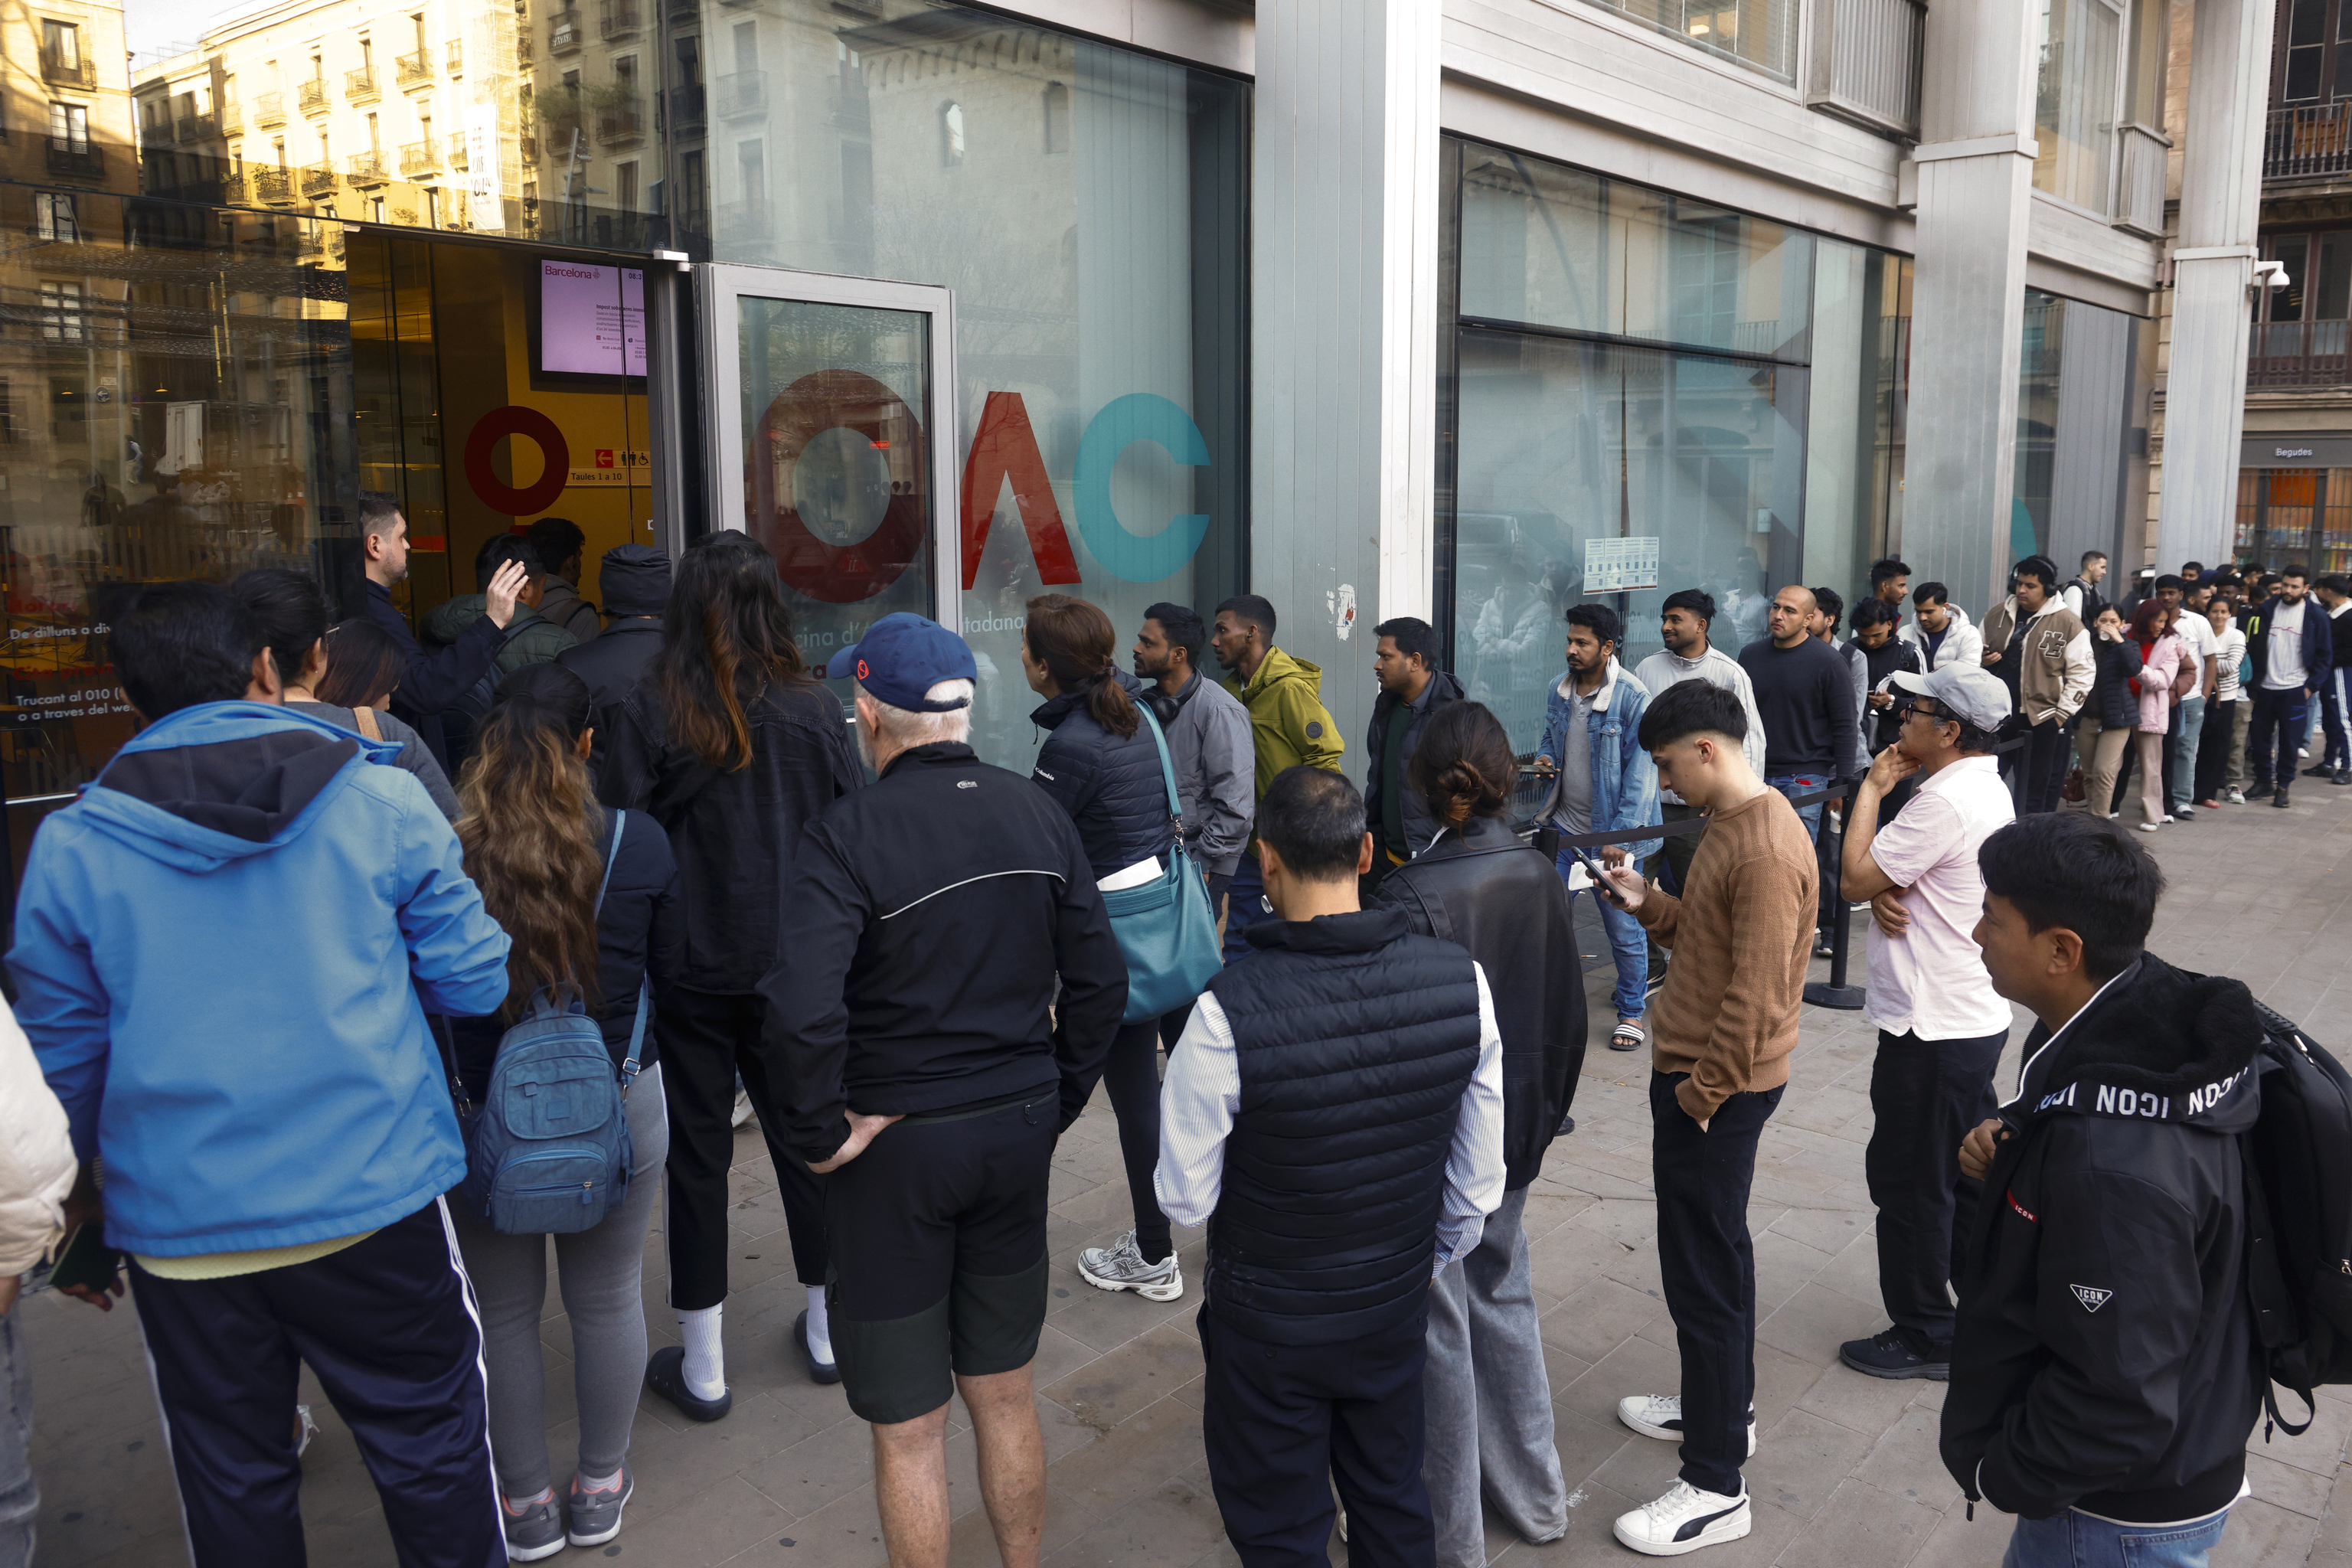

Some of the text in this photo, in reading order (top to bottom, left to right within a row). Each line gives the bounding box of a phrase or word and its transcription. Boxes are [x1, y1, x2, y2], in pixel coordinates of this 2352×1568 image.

[545, 265, 592, 279] Barcelona
[2275, 448, 2312, 458] Begudes
[962, 610, 1024, 634] tadana
[10, 629, 30, 640] De
[34, 626, 77, 638] dilluns
[12, 665, 54, 681] Cita
[16, 693, 66, 706] Trucant
[69, 690, 82, 702] al
[85, 688, 110, 700] 010
[18, 714, 28, 722] o
[31, 712, 41, 720] a
[44, 707, 84, 719] traves
[88, 703, 109, 715] del
[2096, 1084, 2169, 1119] ICON
[2014, 1204, 2034, 1220] ICON
[2079, 1288, 2103, 1301] ICON
